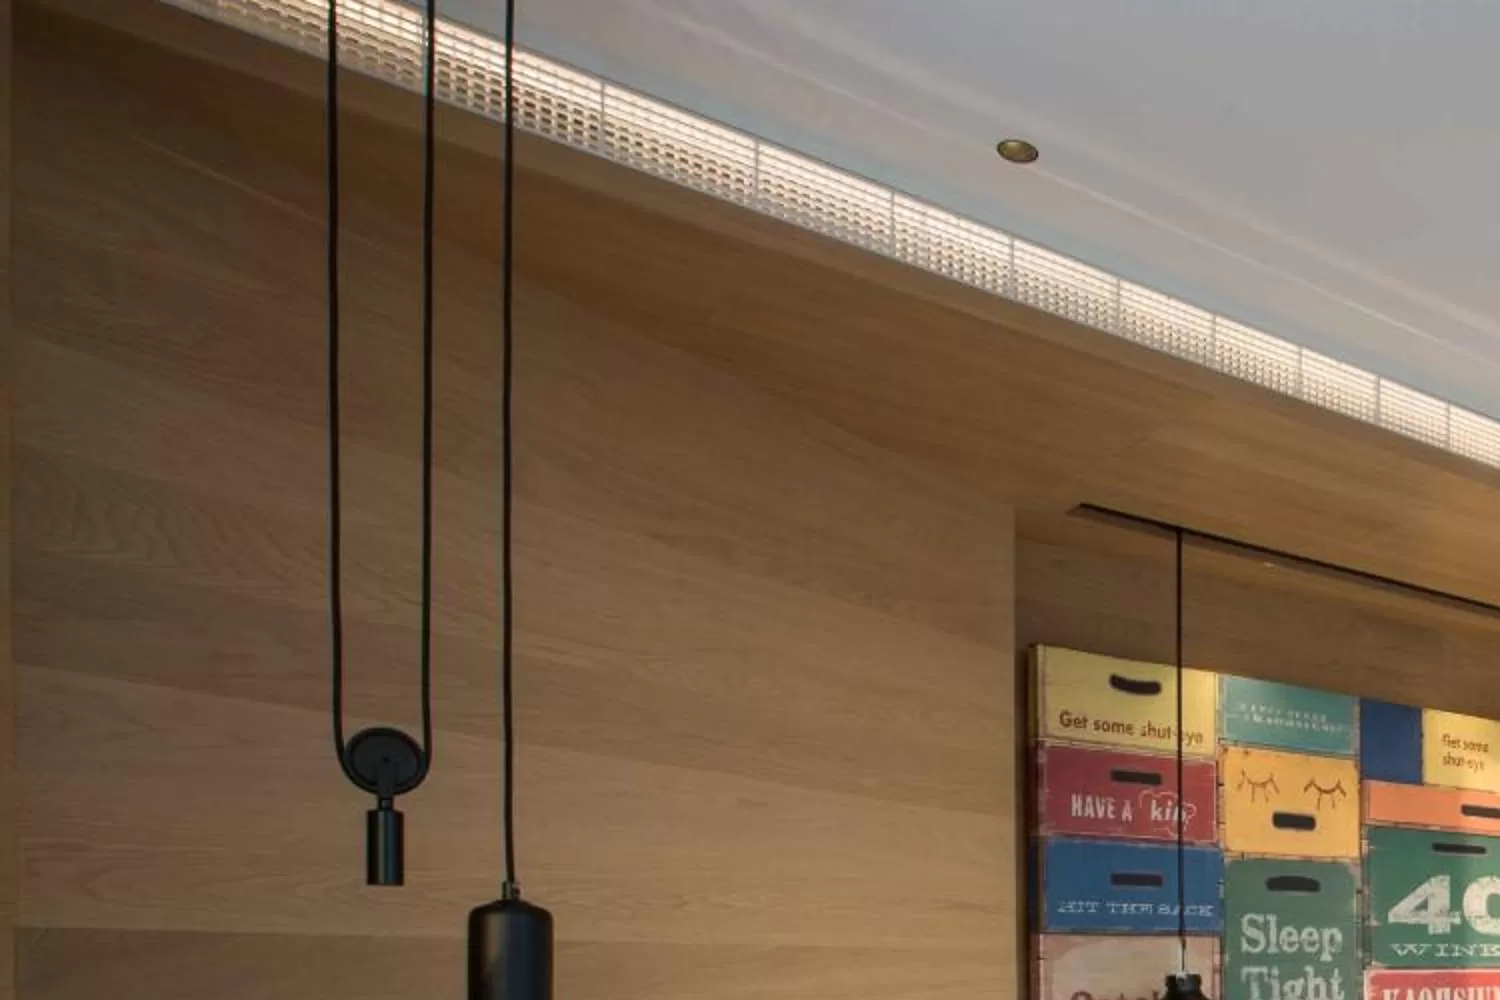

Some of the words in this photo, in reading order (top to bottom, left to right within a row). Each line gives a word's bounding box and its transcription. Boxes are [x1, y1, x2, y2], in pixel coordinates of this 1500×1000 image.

[1058, 709, 1089, 729] Get
[1093, 719, 1135, 736] some
[1070, 792, 1117, 819] HAVE
[1120, 799, 1134, 824] A
[1240, 912, 1343, 962] Sleep
